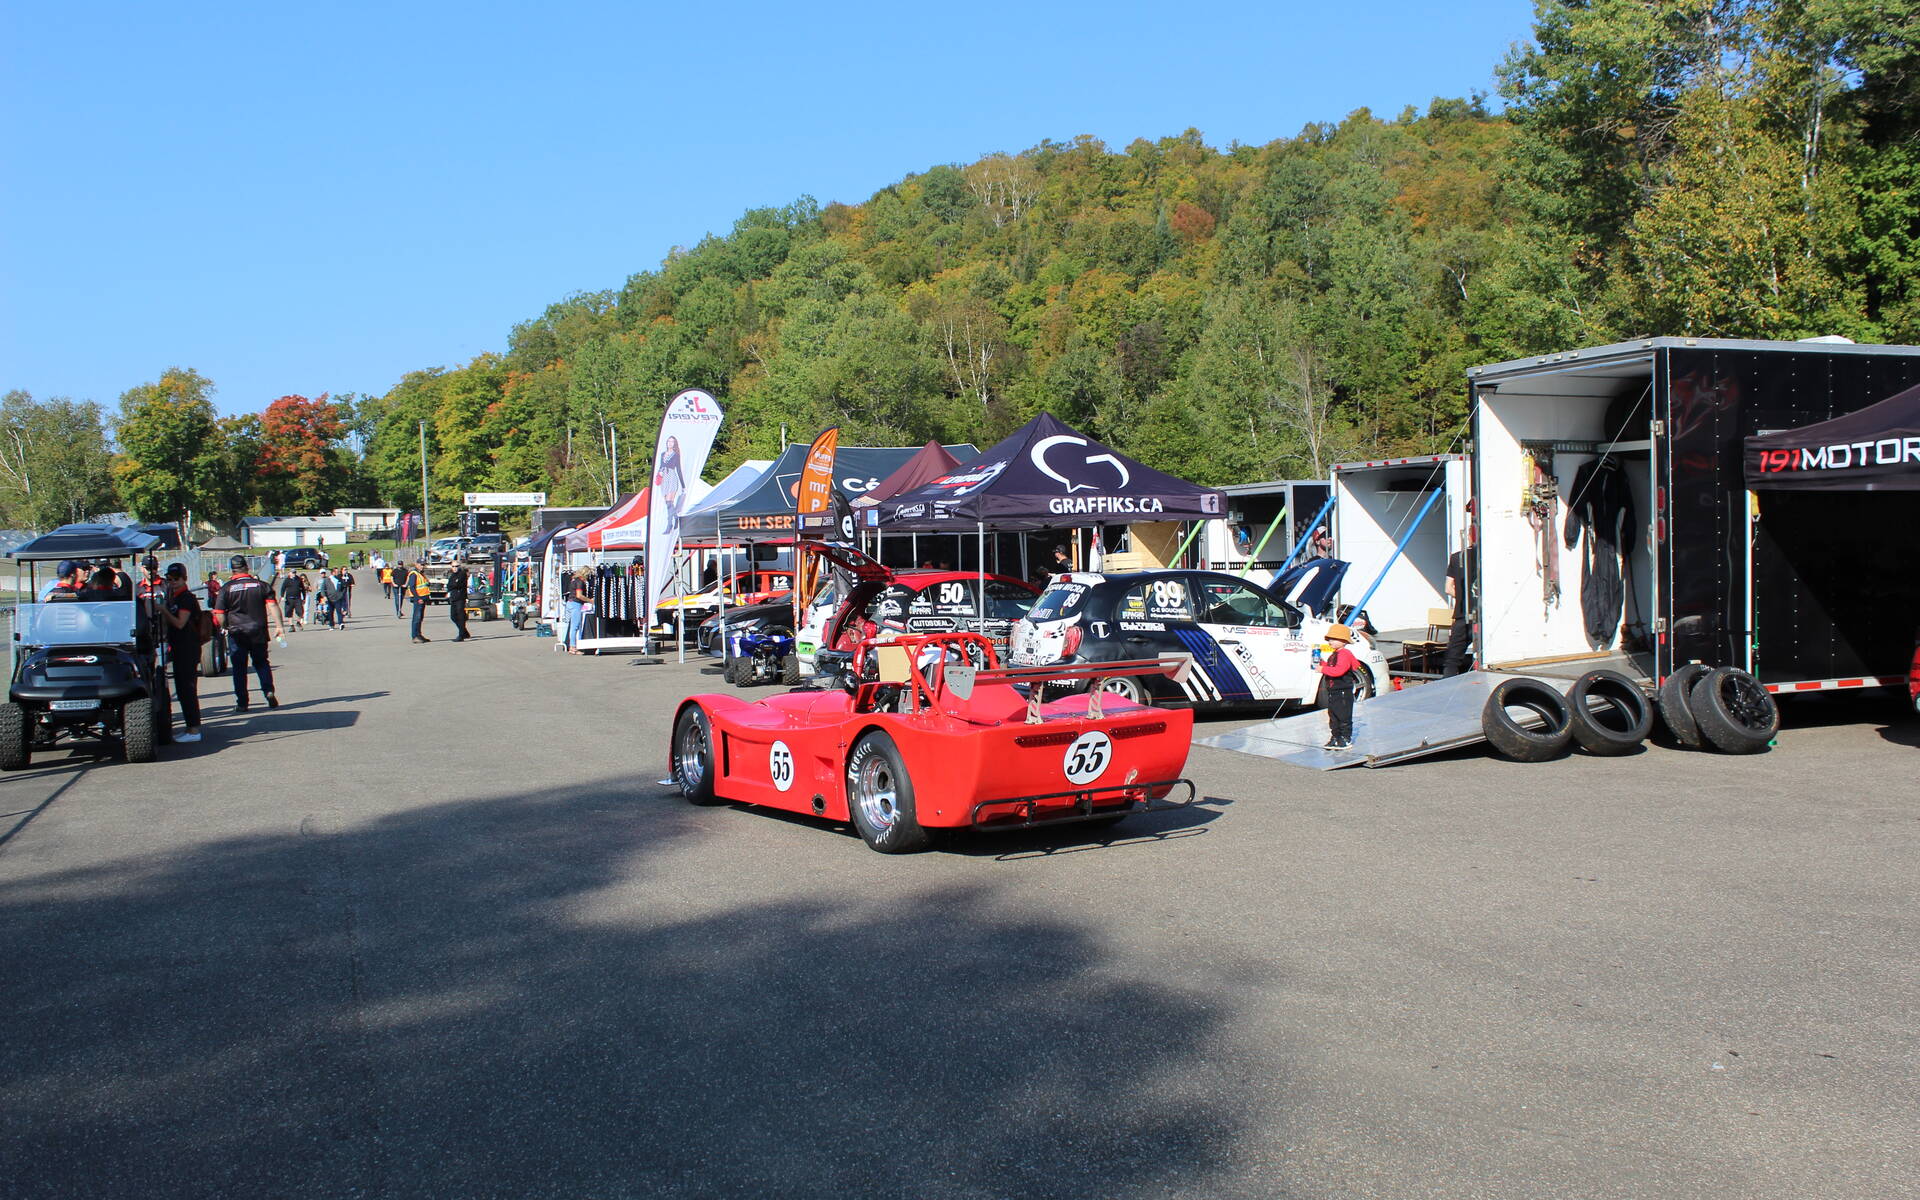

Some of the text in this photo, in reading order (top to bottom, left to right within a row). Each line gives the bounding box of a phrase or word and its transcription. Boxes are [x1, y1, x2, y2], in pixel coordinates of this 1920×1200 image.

[809, 481, 828, 495] mr.
[1049, 497, 1164, 514] GRAFFIKS.CA
[738, 516, 761, 530] UN
[940, 582, 964, 604] 50
[1063, 592, 1081, 608] 89
[1153, 580, 1181, 607] 89
[772, 750, 790, 782] 55
[1067, 741, 1108, 776] 55
